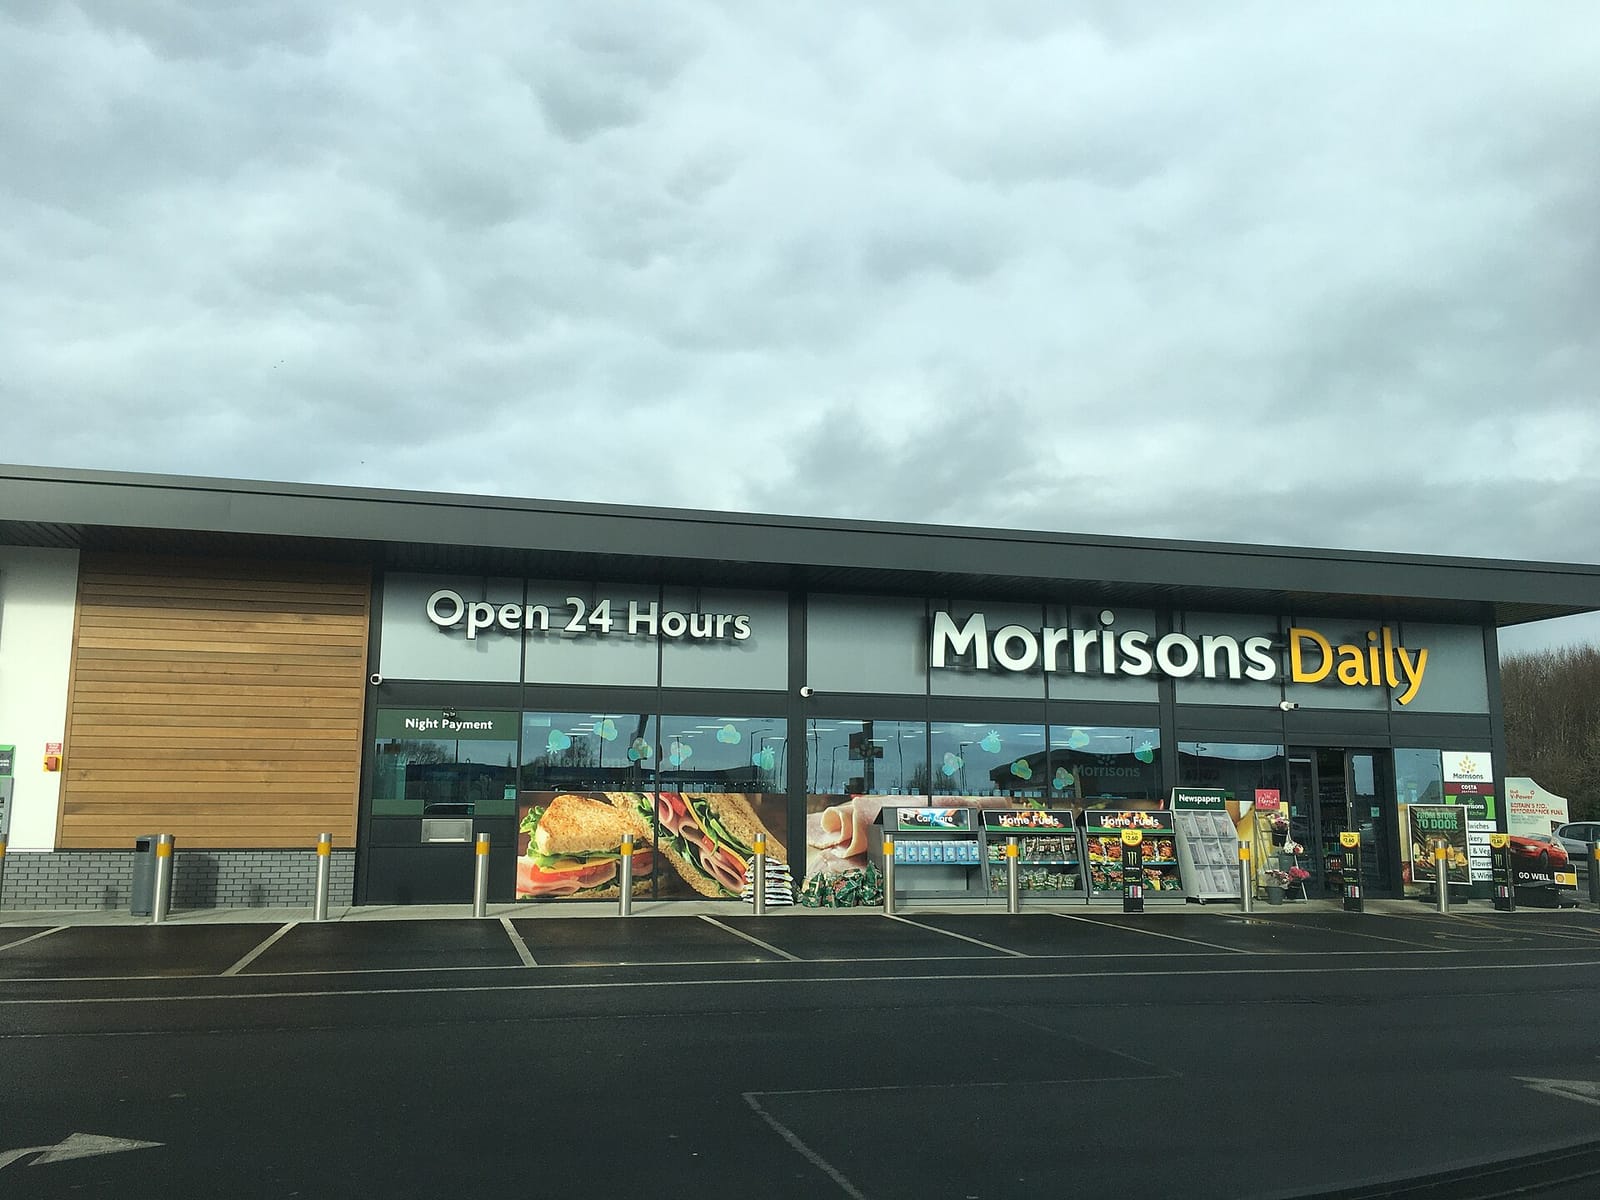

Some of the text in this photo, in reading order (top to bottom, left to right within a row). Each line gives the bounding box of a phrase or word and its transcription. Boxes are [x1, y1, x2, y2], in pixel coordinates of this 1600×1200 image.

[426, 589, 751, 640] Open 24 Hours
[931, 609, 1429, 705] Morrisons Daily
[405, 718, 493, 731] Night Payment
[1073, 764, 1141, 777] Morrisons
[1453, 771, 1484, 780] Morrisons
[1178, 794, 1221, 804] Newspapers
[916, 814, 931, 823] Car
[998, 815, 1059, 826] Home Fuels
[1417, 811, 1457, 820] FROM STORE
[1100, 816, 1159, 826] Home Fuels
[1417, 819, 1457, 829] TO DOOR
